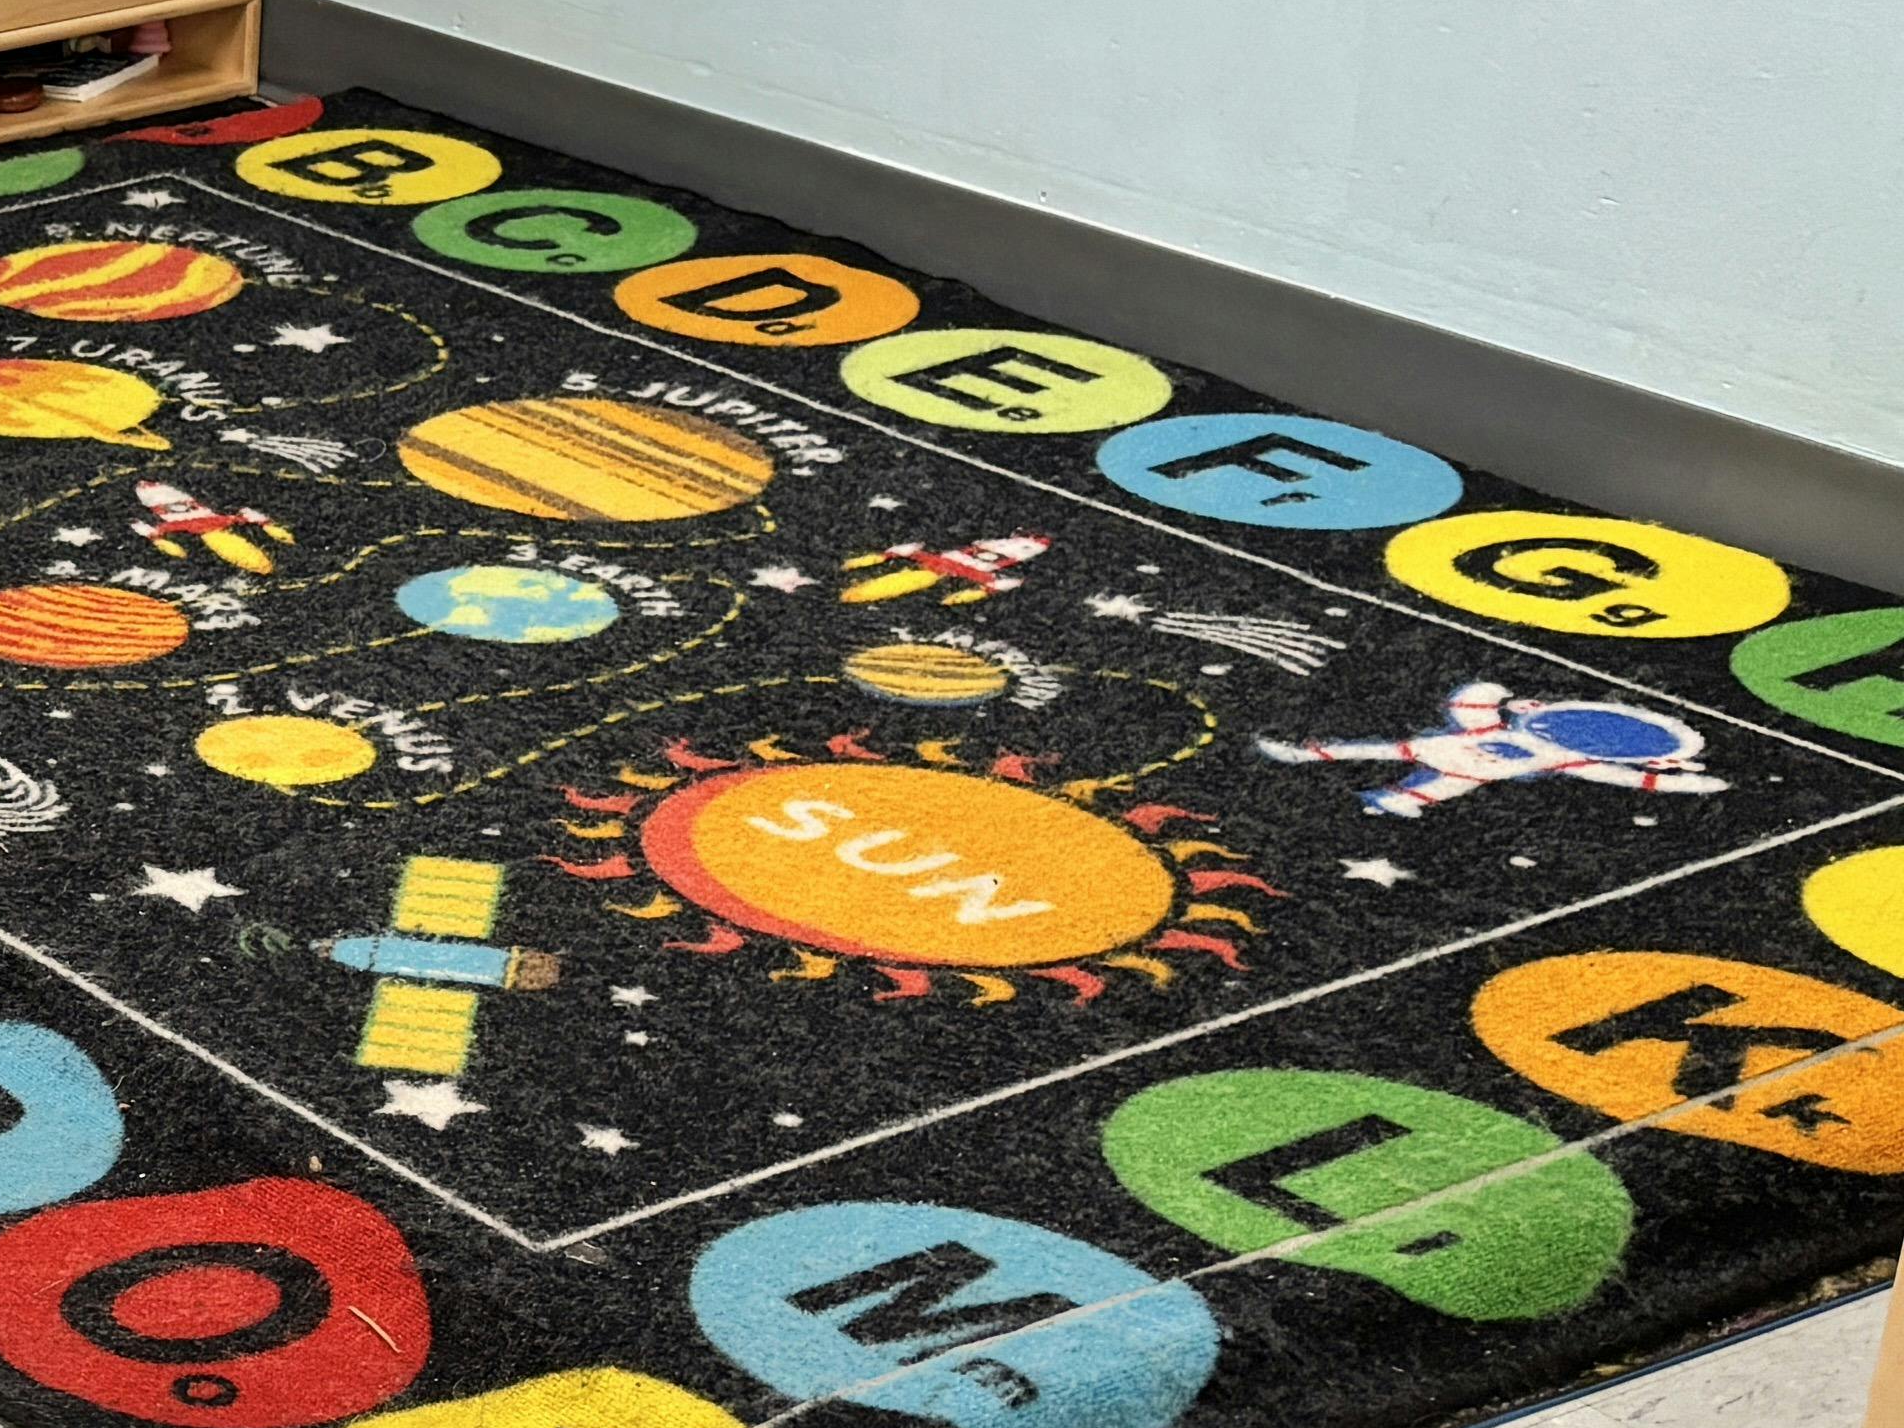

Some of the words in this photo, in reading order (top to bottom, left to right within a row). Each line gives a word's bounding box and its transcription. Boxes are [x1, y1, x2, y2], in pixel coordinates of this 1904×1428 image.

[266, 139, 438, 188] B
[105, 222, 312, 289] NEPTUNE
[463, 201, 623, 252] C
[656, 265, 843, 323] D
[70, 339, 233, 422] URANUS
[885, 345, 1101, 413] E
[626, 381, 844, 464] JUPITER
[1149, 431, 1376, 486] F
[109, 565, 263, 632] MARS
[1448, 536, 1663, 602] G
[286, 689, 454, 774] VENUS
[744, 794, 1058, 926] SUN
[1546, 982, 1884, 1112] K
[1201, 1111, 1421, 1232] L
[60, 1241, 331, 1364] O
[784, 1239, 1083, 1368] M
